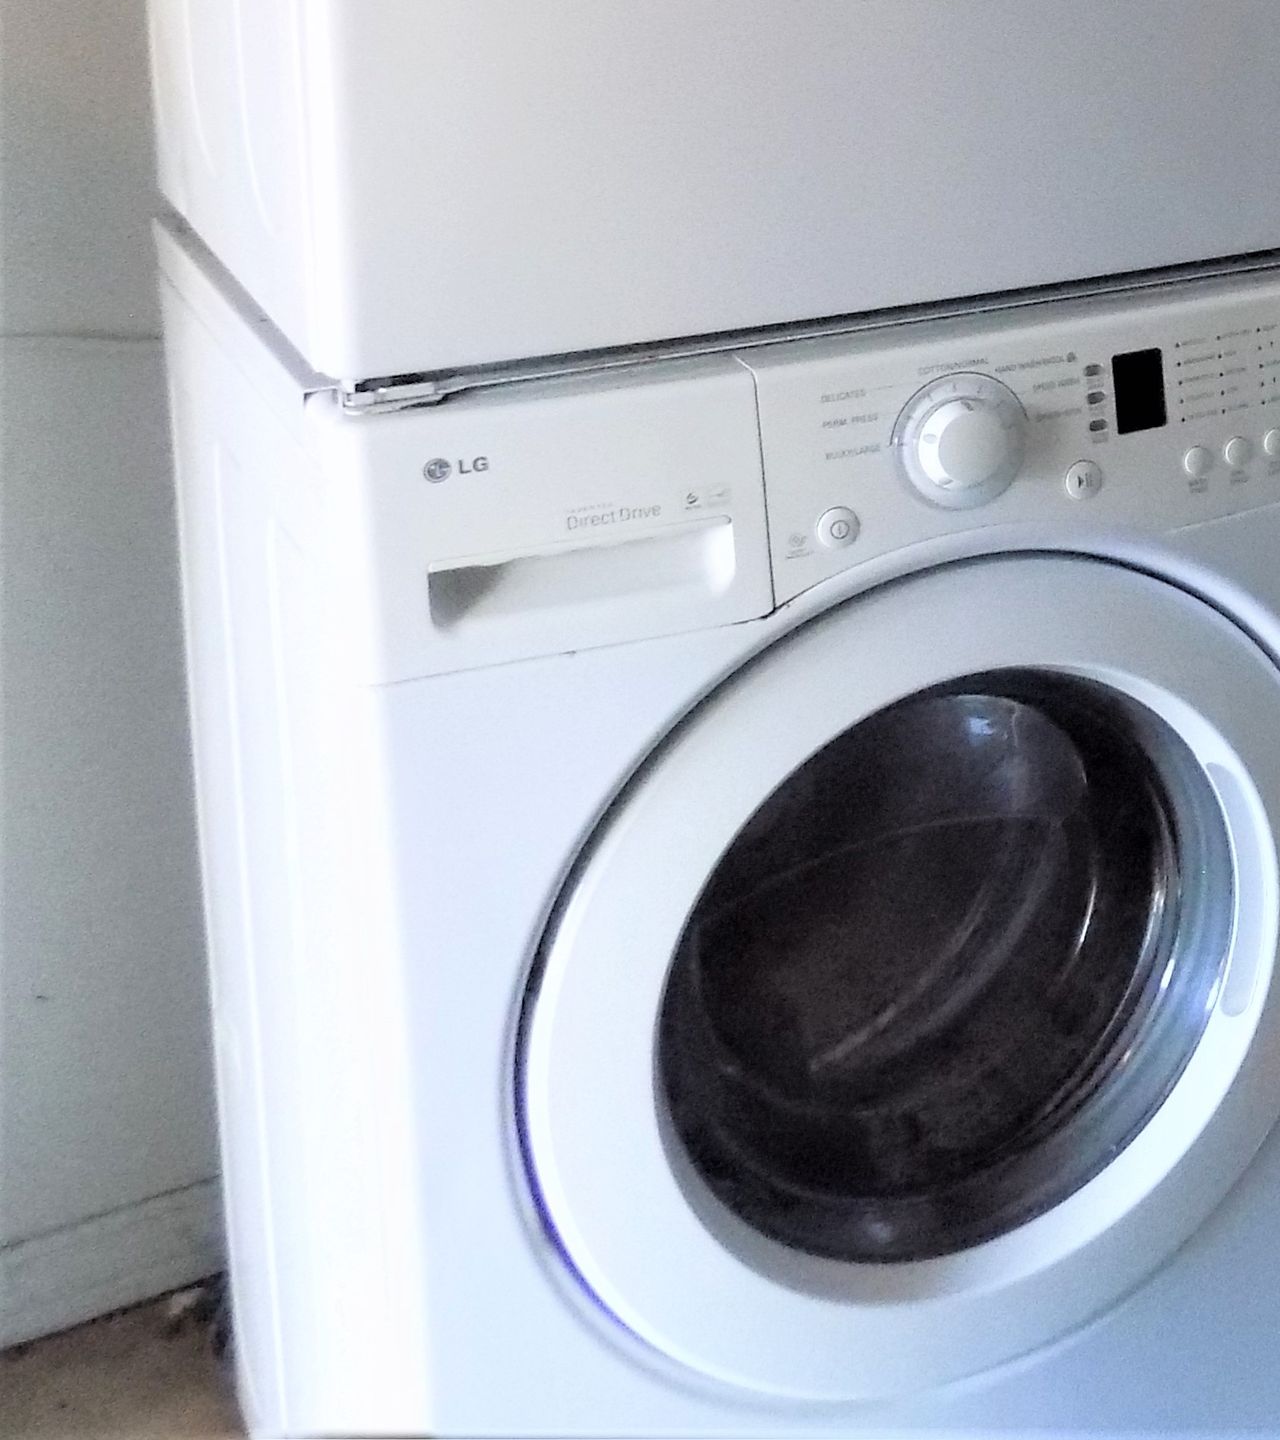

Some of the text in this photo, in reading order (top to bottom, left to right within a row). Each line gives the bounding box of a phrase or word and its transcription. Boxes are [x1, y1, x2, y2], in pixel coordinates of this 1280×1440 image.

[458, 456, 489, 474] LG
[567, 511, 616, 531] Direct
[619, 503, 662, 522] Drive
